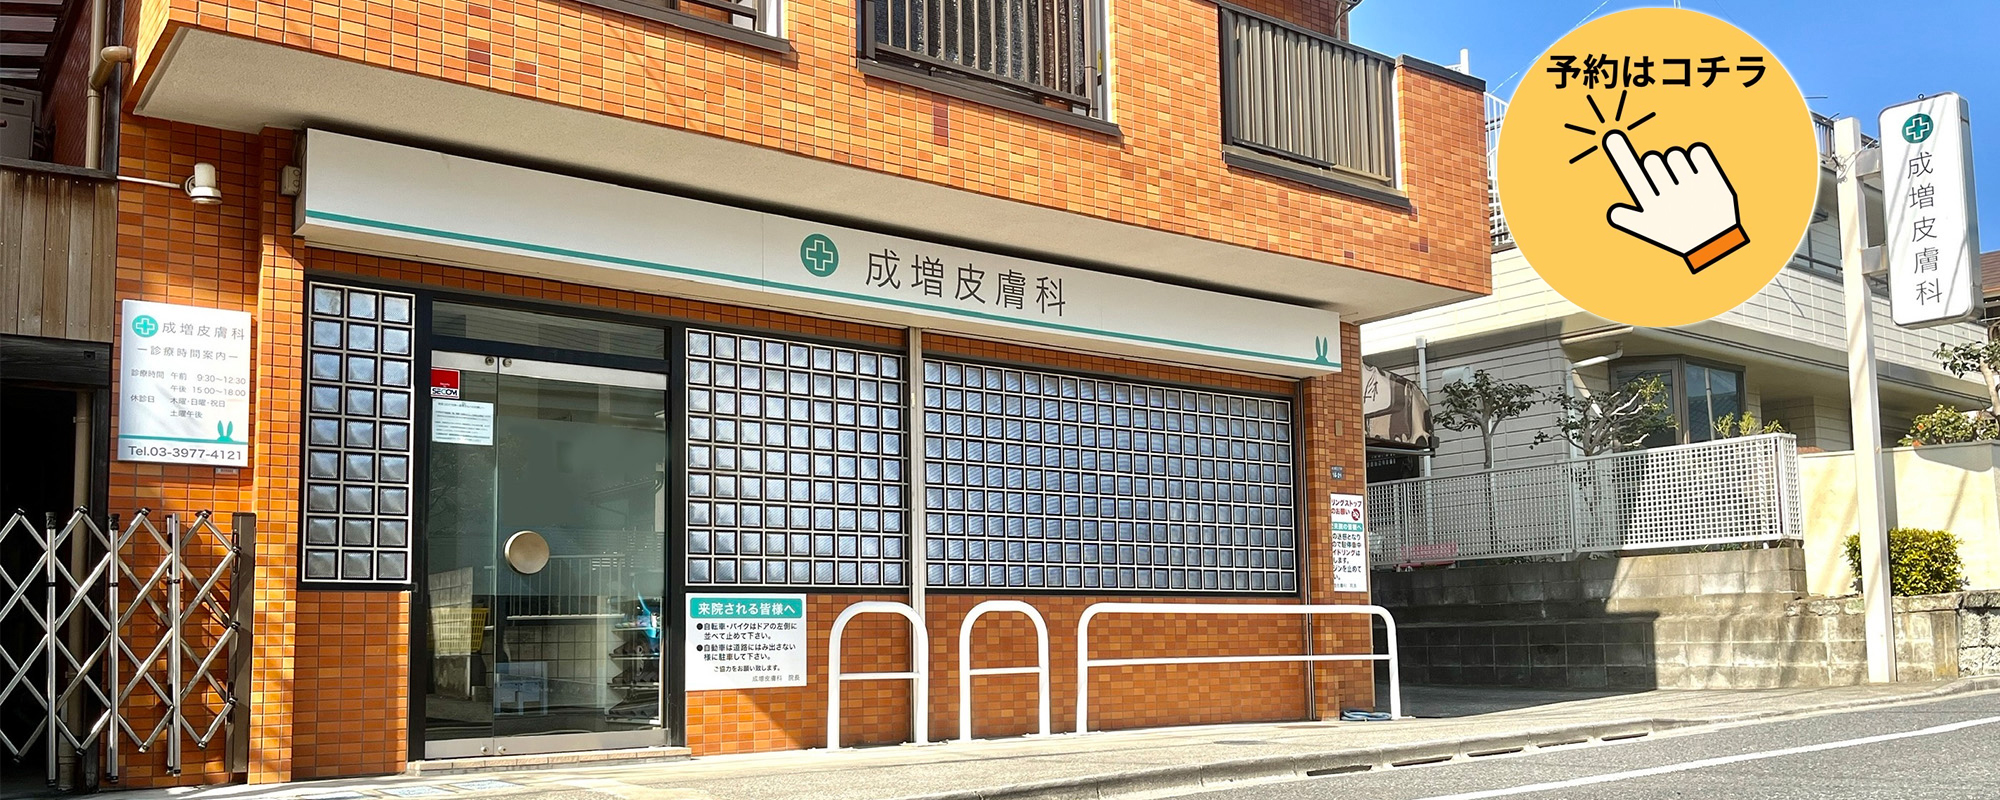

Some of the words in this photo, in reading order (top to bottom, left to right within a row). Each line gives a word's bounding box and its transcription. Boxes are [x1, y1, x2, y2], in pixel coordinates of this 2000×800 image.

[1907, 151, 1943, 306] 成増皮膚科
[865, 248, 1067, 317] 成増皮膚科
[162, 321, 245, 341] 成増皮膚科
[131, 368, 165, 379] 診療時間
[170, 371, 187, 381] 午前
[170, 384, 187, 394] 午後
[432, 387, 458, 396] SECOM
[130, 394, 156, 404] 休診日
[170, 409, 204, 419] 土曜午後
[128, 445, 242, 461] Tel.03-3977-4121
[698, 602, 795, 616] 来院される皆様へ
[703, 631, 772, 641] 並べて止めて下さい。
[703, 643, 796, 653] 自動車は道路にはみ出さない
[703, 652, 771, 662] 様に駐車して下さい。
